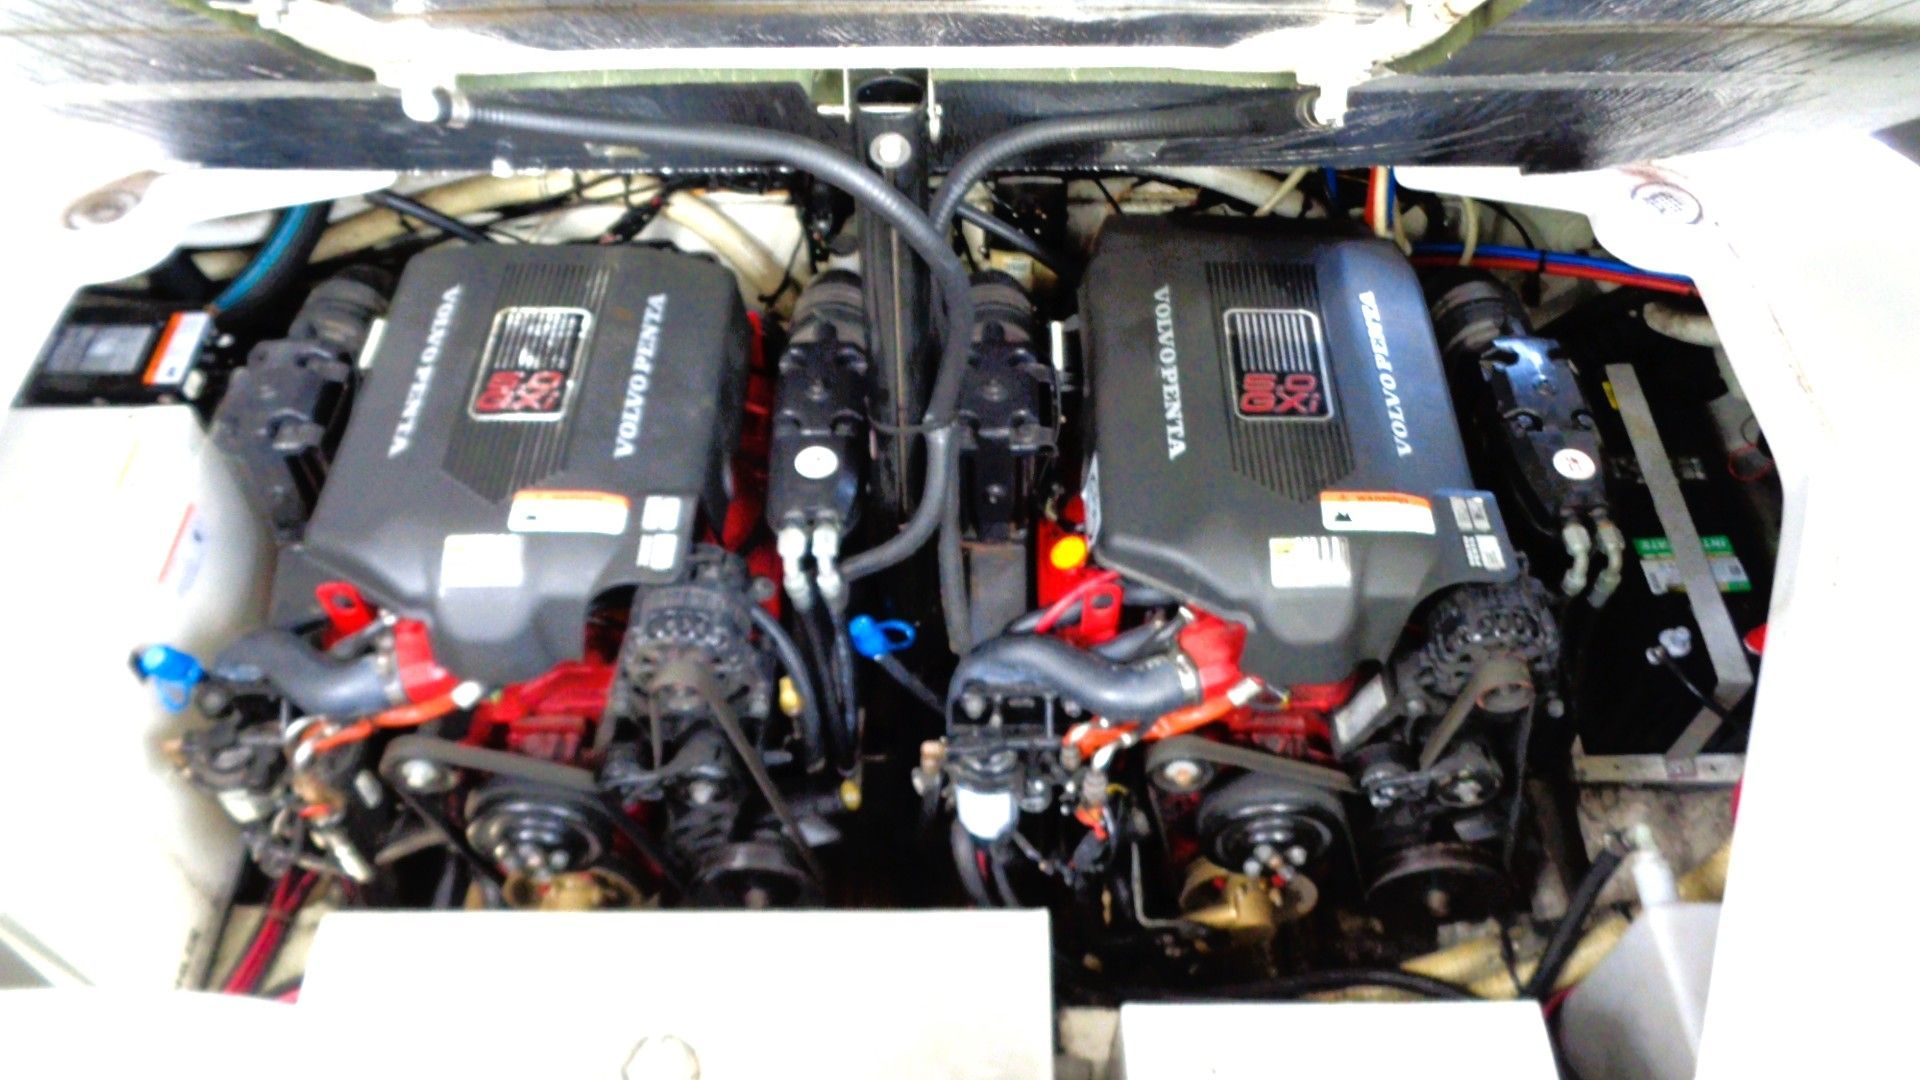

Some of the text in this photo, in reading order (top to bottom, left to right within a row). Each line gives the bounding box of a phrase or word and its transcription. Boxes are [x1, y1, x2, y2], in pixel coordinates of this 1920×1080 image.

[388, 284, 462, 458] VOLVO PENTA
[613, 293, 667, 458] VOLVO PENTA
[1154, 285, 1187, 460] VOLVO PENTA
[1358, 290, 1412, 457] VOLVO PENTA
